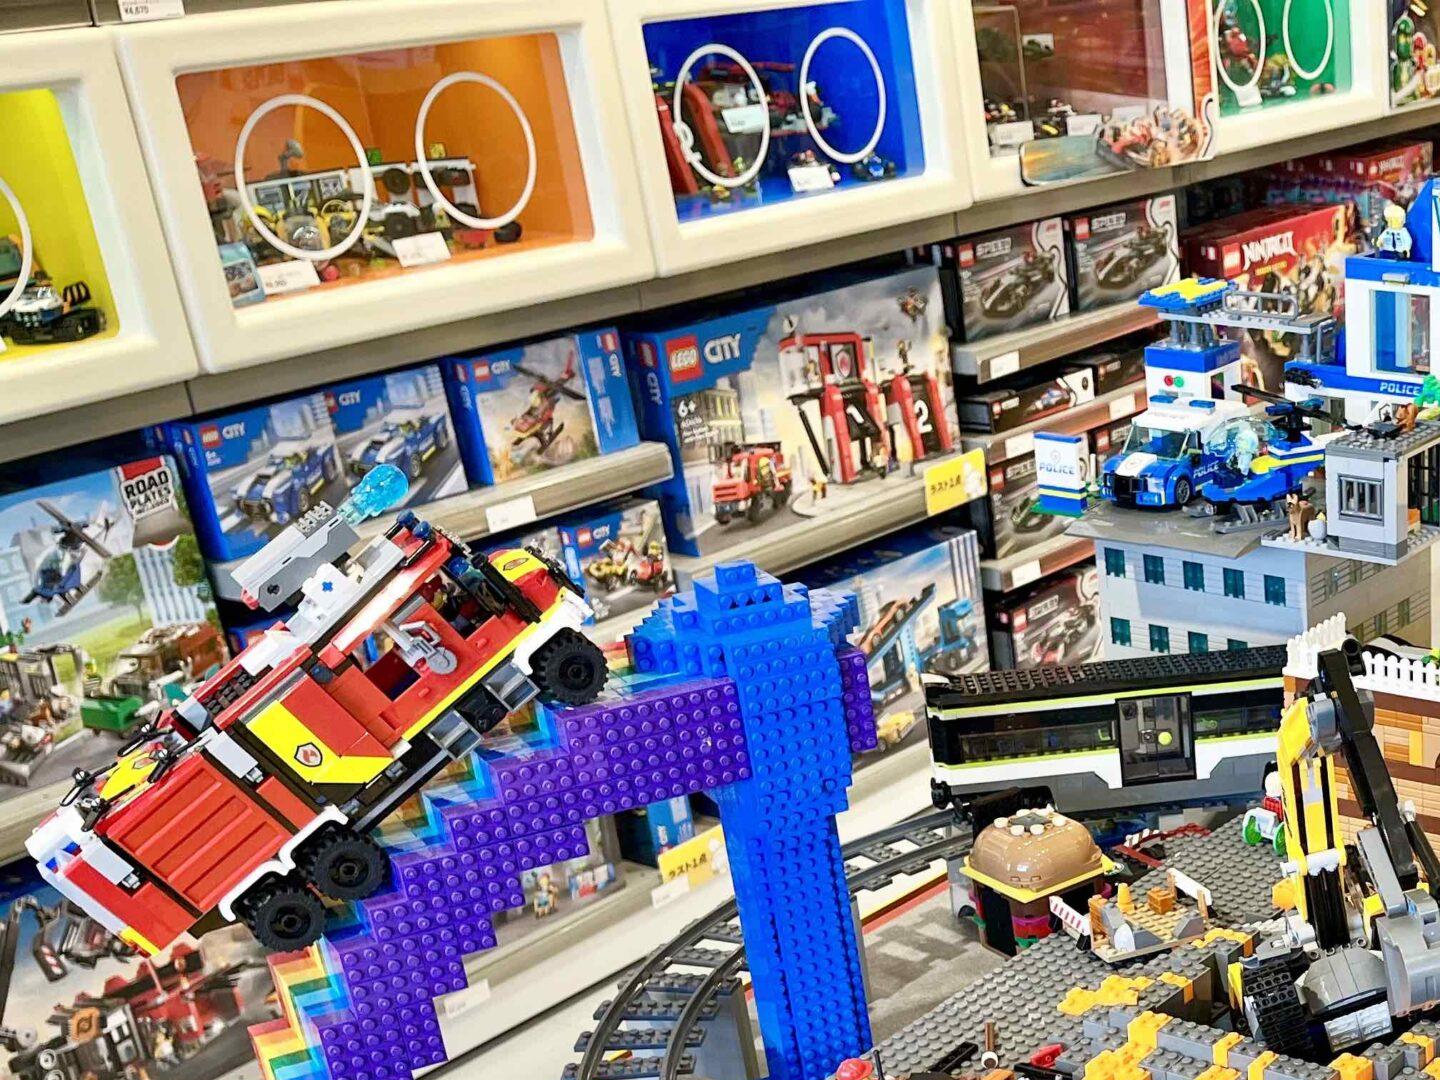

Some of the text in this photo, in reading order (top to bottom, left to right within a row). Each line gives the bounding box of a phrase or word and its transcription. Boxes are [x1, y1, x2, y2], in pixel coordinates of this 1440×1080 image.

[670, 333, 741, 370] LEGO CITY
[1380, 382, 1420, 395] POLICE
[678, 400, 696, 417] 6+
[914, 400, 933, 433] 2
[1039, 462, 1075, 475] POLICE
[124, 470, 169, 499] ROAD
[130, 486, 171, 509] PLATES
